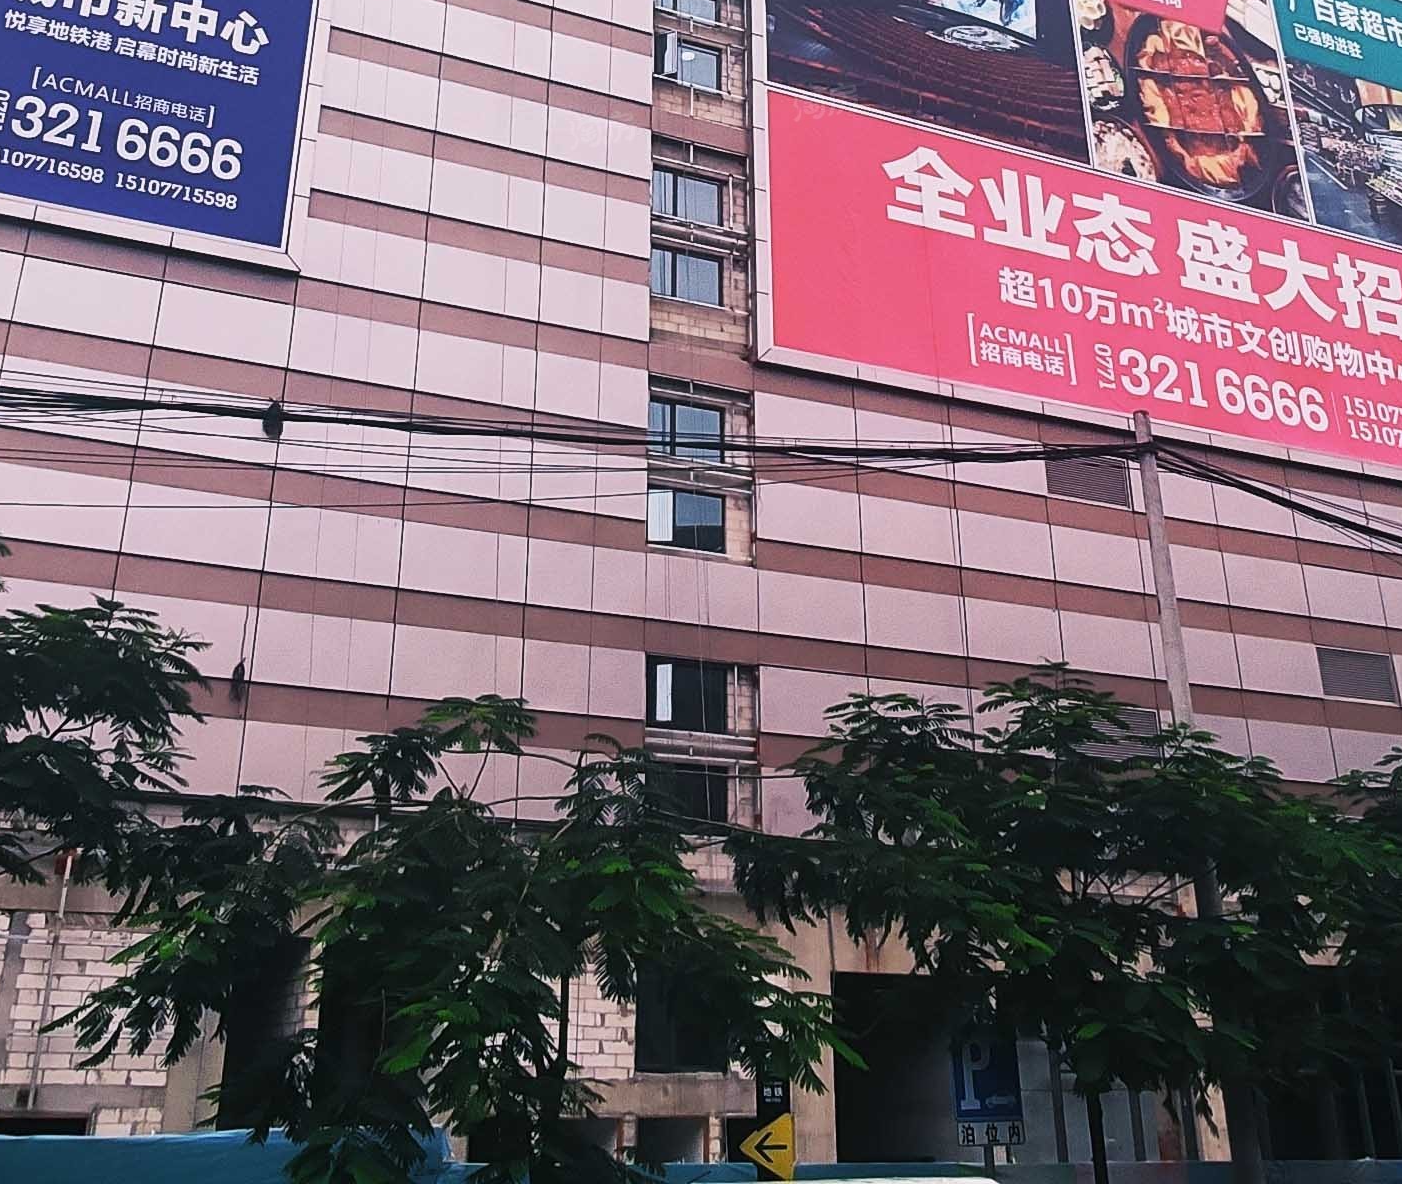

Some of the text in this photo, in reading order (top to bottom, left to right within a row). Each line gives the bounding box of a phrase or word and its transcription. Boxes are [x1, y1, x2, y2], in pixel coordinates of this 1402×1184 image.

[4, 9, 260, 86] 悦享地铁港 启幕时尚新生活
[1293, 23, 1364, 59] 已强势进驻
[11, 95, 243, 180] 321 6666
[116, 172, 238, 210] 15107715598
[882, 146, 1160, 277] 全业态
[979, 323, 1066, 355] ACMALL
[980, 341, 1065, 376] 招商电话
[1094, 343, 1116, 389] 0771
[1119, 348, 1329, 432] 321 6666
[962, 1124, 1021, 1144] 泊位内
